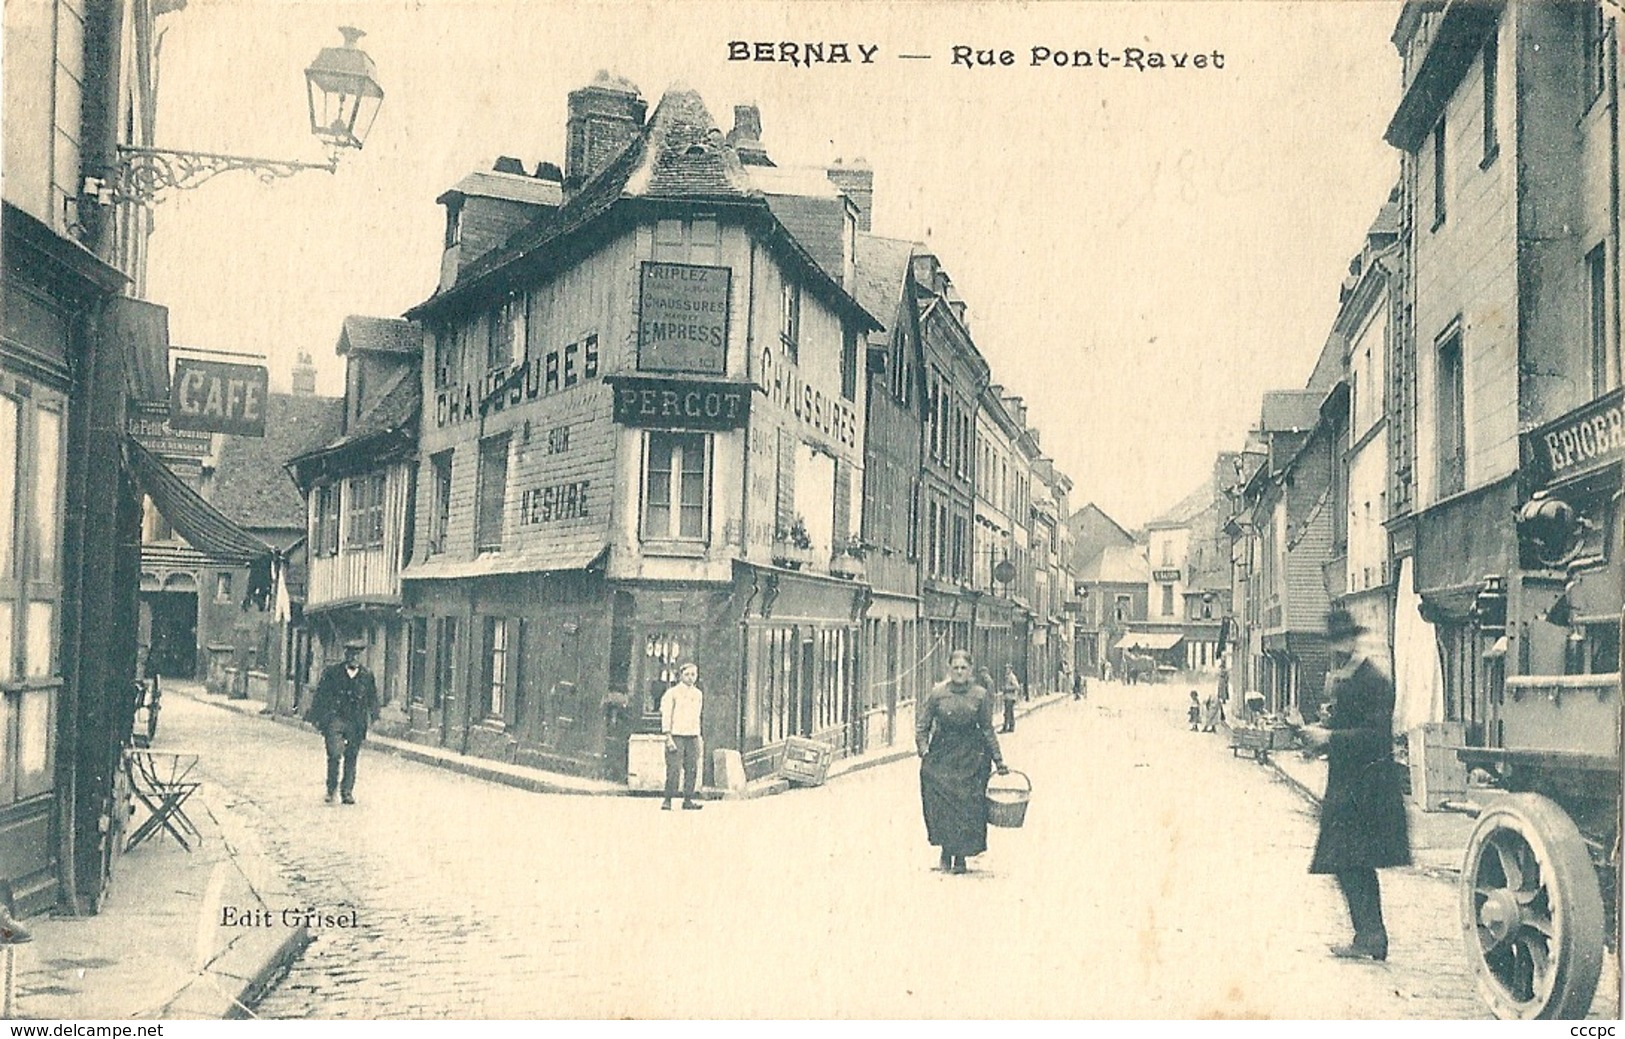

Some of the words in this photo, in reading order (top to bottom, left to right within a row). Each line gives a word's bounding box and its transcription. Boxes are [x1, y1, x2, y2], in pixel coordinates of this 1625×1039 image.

[644, 293, 725, 313] CHAUSSURES
[638, 321, 723, 347] EMPRESS
[759, 346, 856, 449] CHAUSSURES
[549, 426, 570, 454] SUR
